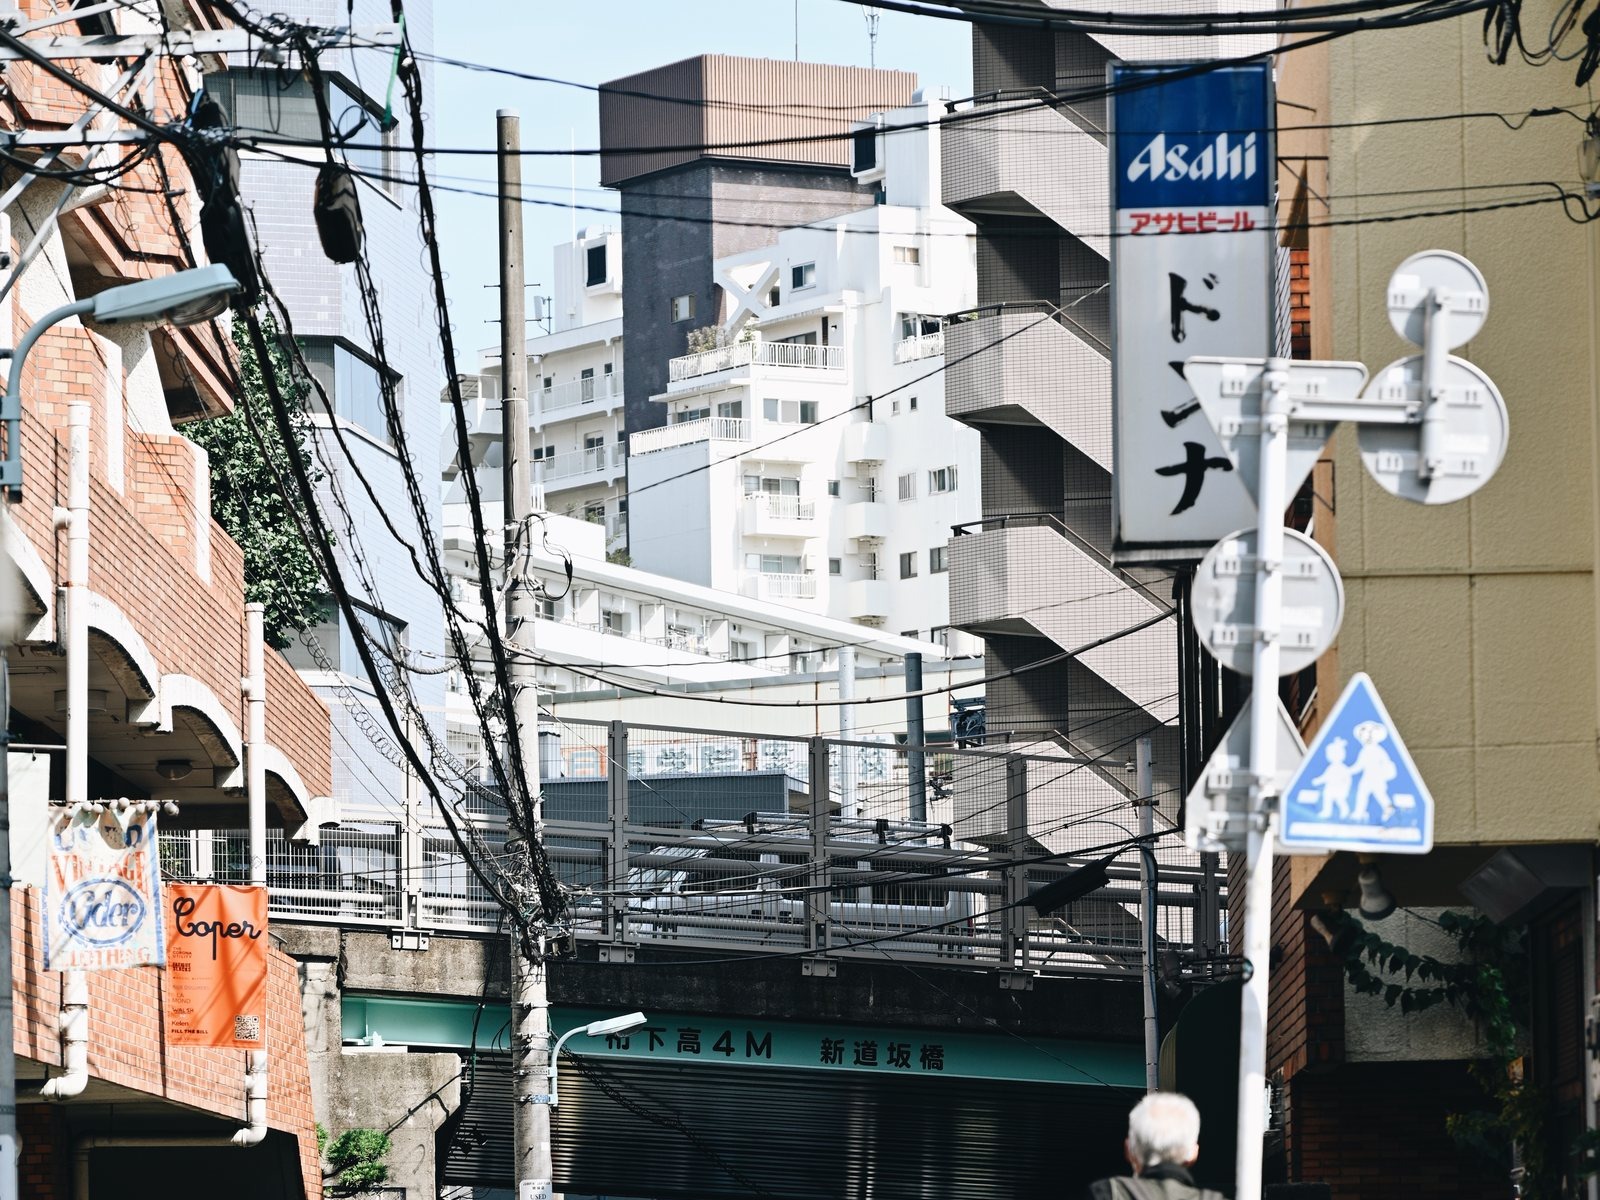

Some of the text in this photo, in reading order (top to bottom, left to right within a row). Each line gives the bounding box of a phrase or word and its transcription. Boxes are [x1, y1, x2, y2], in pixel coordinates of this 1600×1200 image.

[1127, 131, 1257, 183] Asahi
[1129, 211, 1255, 235] アサヒビール
[172, 896, 262, 961] Coper
[820, 1037, 945, 1071] 新道坂橋
